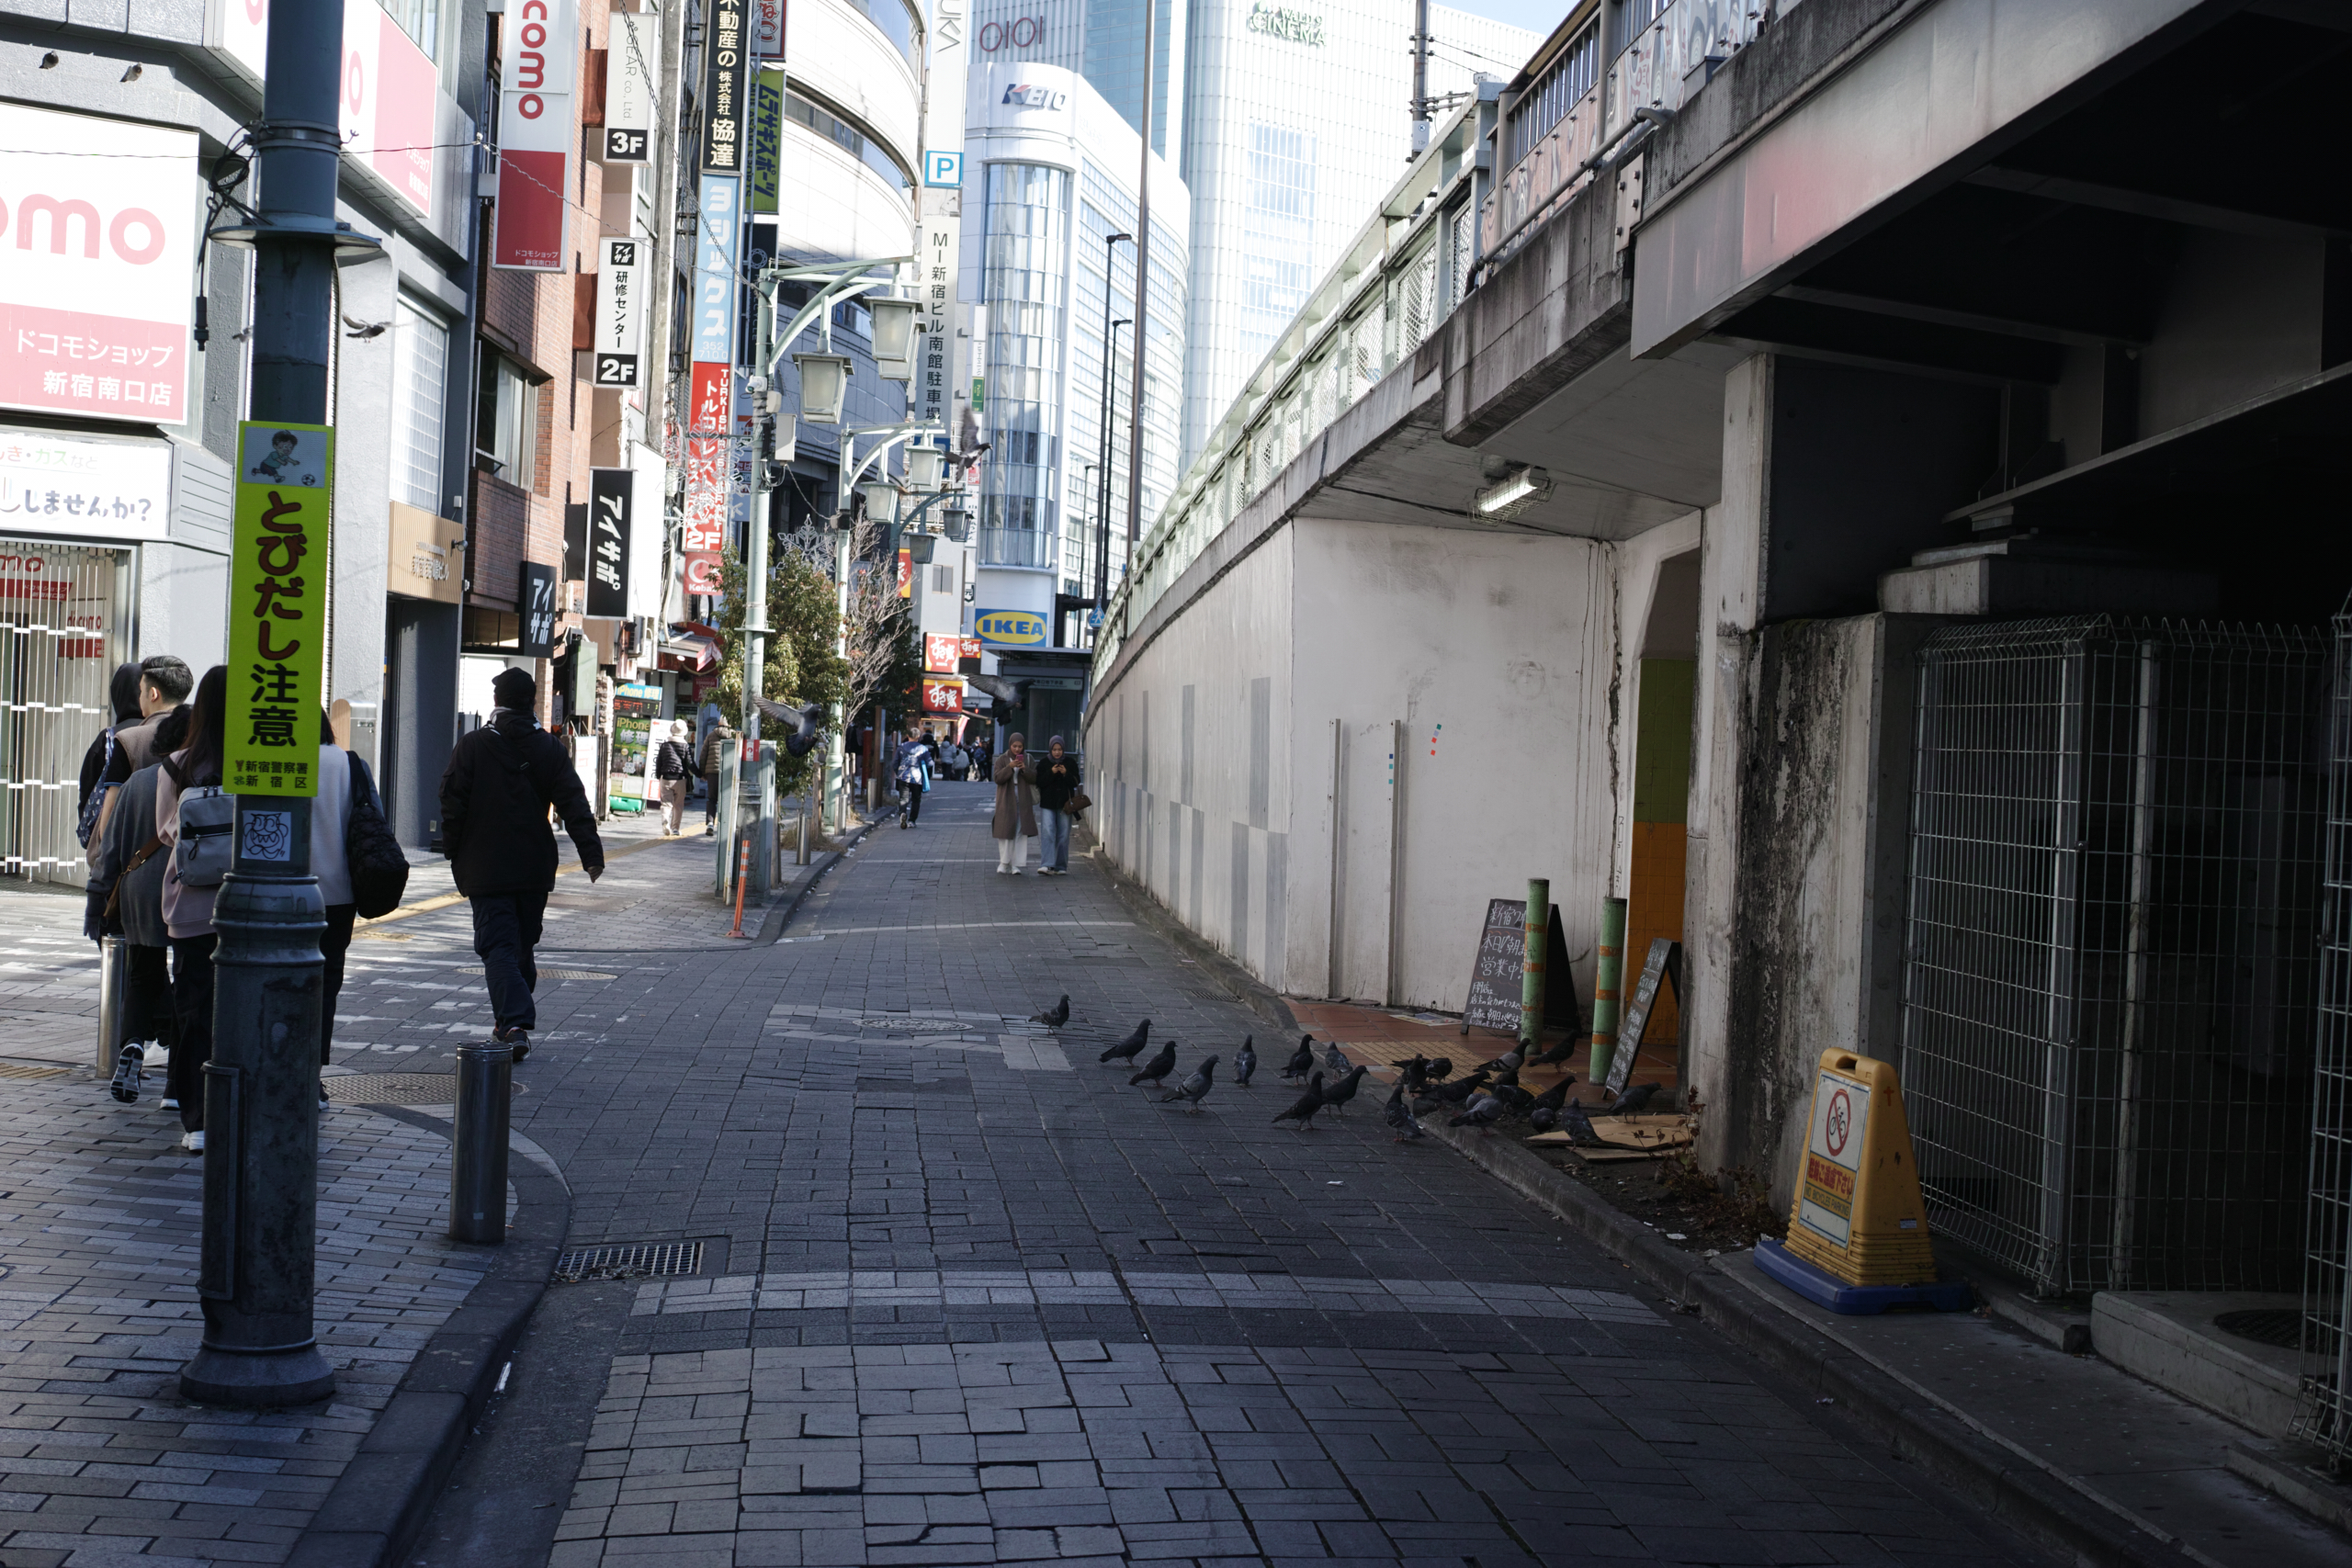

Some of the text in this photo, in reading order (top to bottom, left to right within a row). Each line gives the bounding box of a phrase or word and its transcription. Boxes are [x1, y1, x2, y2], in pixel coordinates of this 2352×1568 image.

[1251, 12, 1327, 46] CINEMA
[1001, 84, 1066, 111] KEIO
[611, 131, 644, 154] 3F
[753, 83, 779, 198] ムラサキスポーツ
[936, 157, 955, 179] P
[0, 194, 166, 265] mo
[515, 249, 559, 259] ドコモショップ
[525, 258, 558, 268] 新宿南口店
[615, 270, 628, 348] 研修センター
[17, 329, 173, 367] ドコモショップ
[600, 358, 635, 381] 2F
[43, 370, 173, 406] 新宿南口店
[718, 368, 729, 434] TURKISH
[0, 446, 99, 469] き・ガスなど
[595, 494, 623, 591] アイサポ
[686, 531, 721, 549] 2F
[248, 491, 308, 747] とびだし注意
[982, 619, 1044, 637] IKEA
[930, 637, 956, 662] すき家
[617, 684, 643, 697] iPhone
[928, 681, 957, 711] すき家
[616, 717, 650, 731] iPhone
[620, 729, 650, 746] 修理
[245, 760, 309, 774] 新宿警察署
[1808, 1157, 1854, 1195] 駐輪ご遠慮下さい
[1805, 1186, 1849, 1217] NO BICYCLES PARKING
